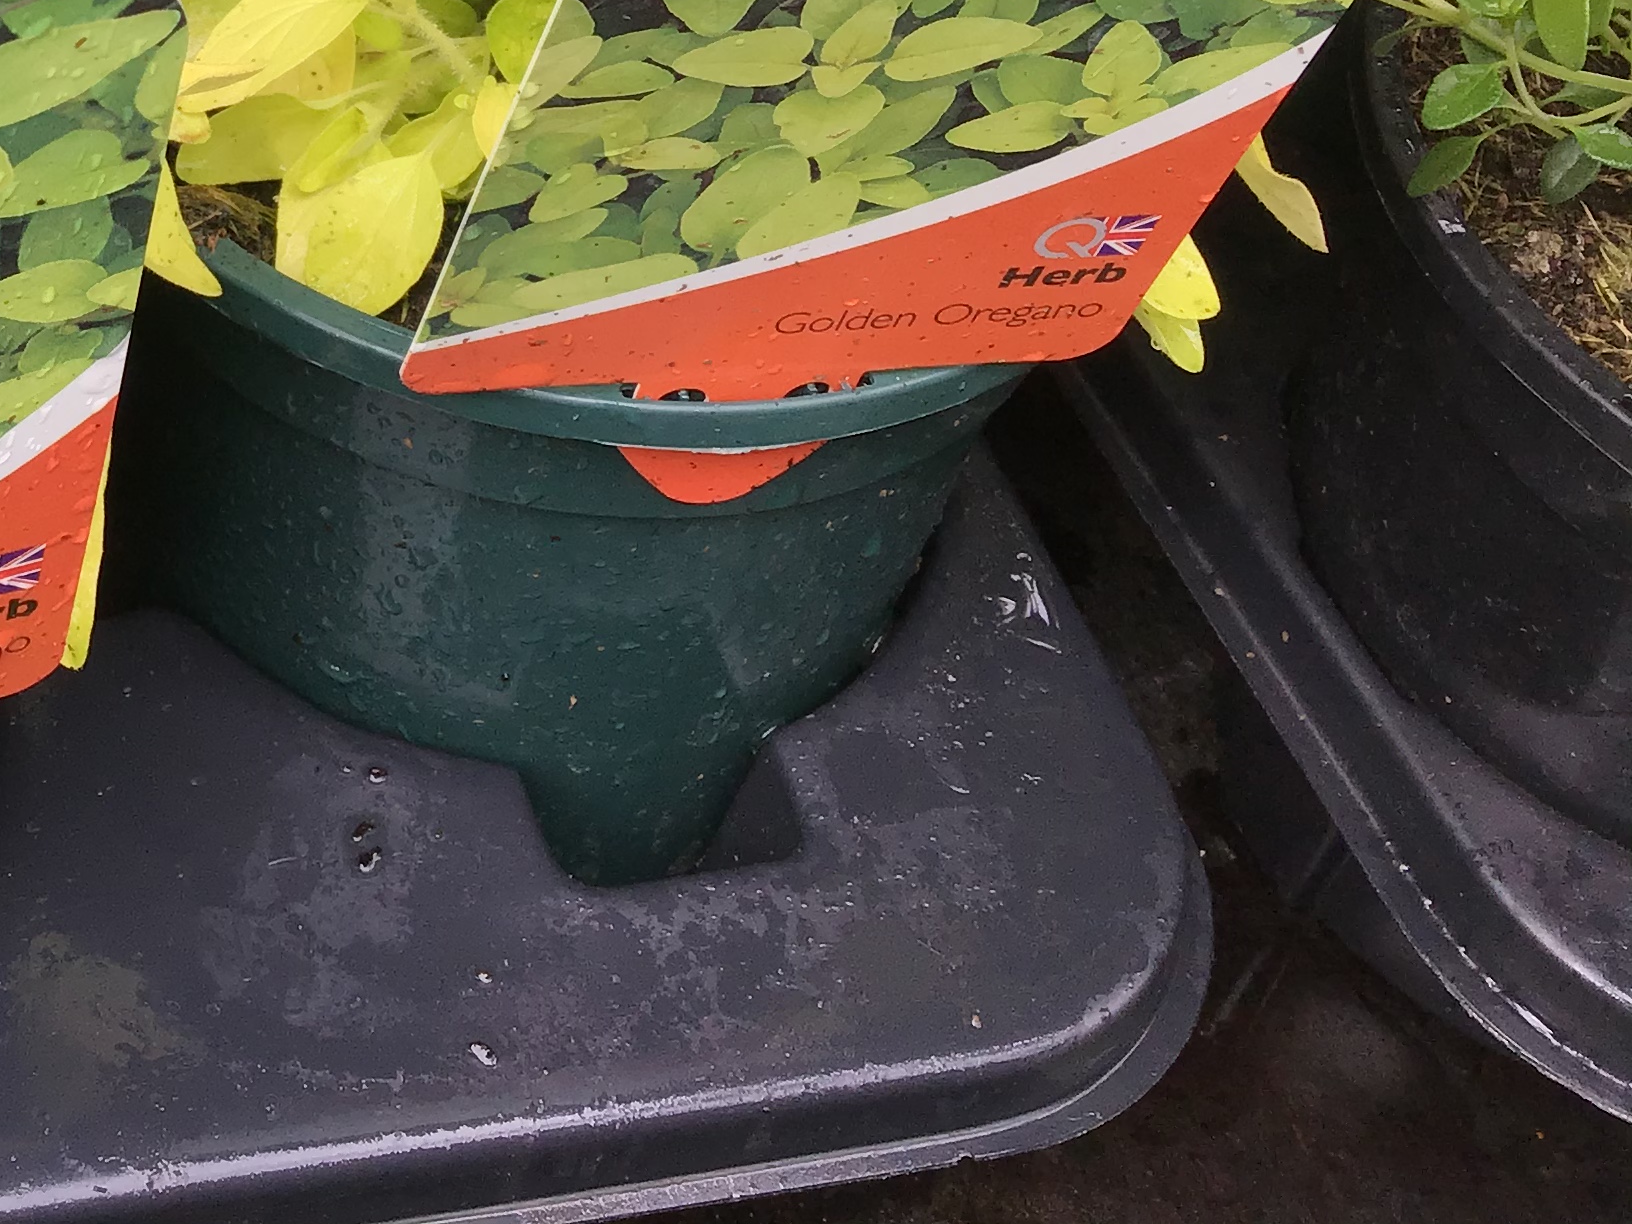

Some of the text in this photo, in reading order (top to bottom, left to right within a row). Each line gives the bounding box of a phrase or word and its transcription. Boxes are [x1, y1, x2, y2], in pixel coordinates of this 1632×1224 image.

[998, 262, 1127, 289] Herb
[775, 302, 1103, 335] Golden Oregano
